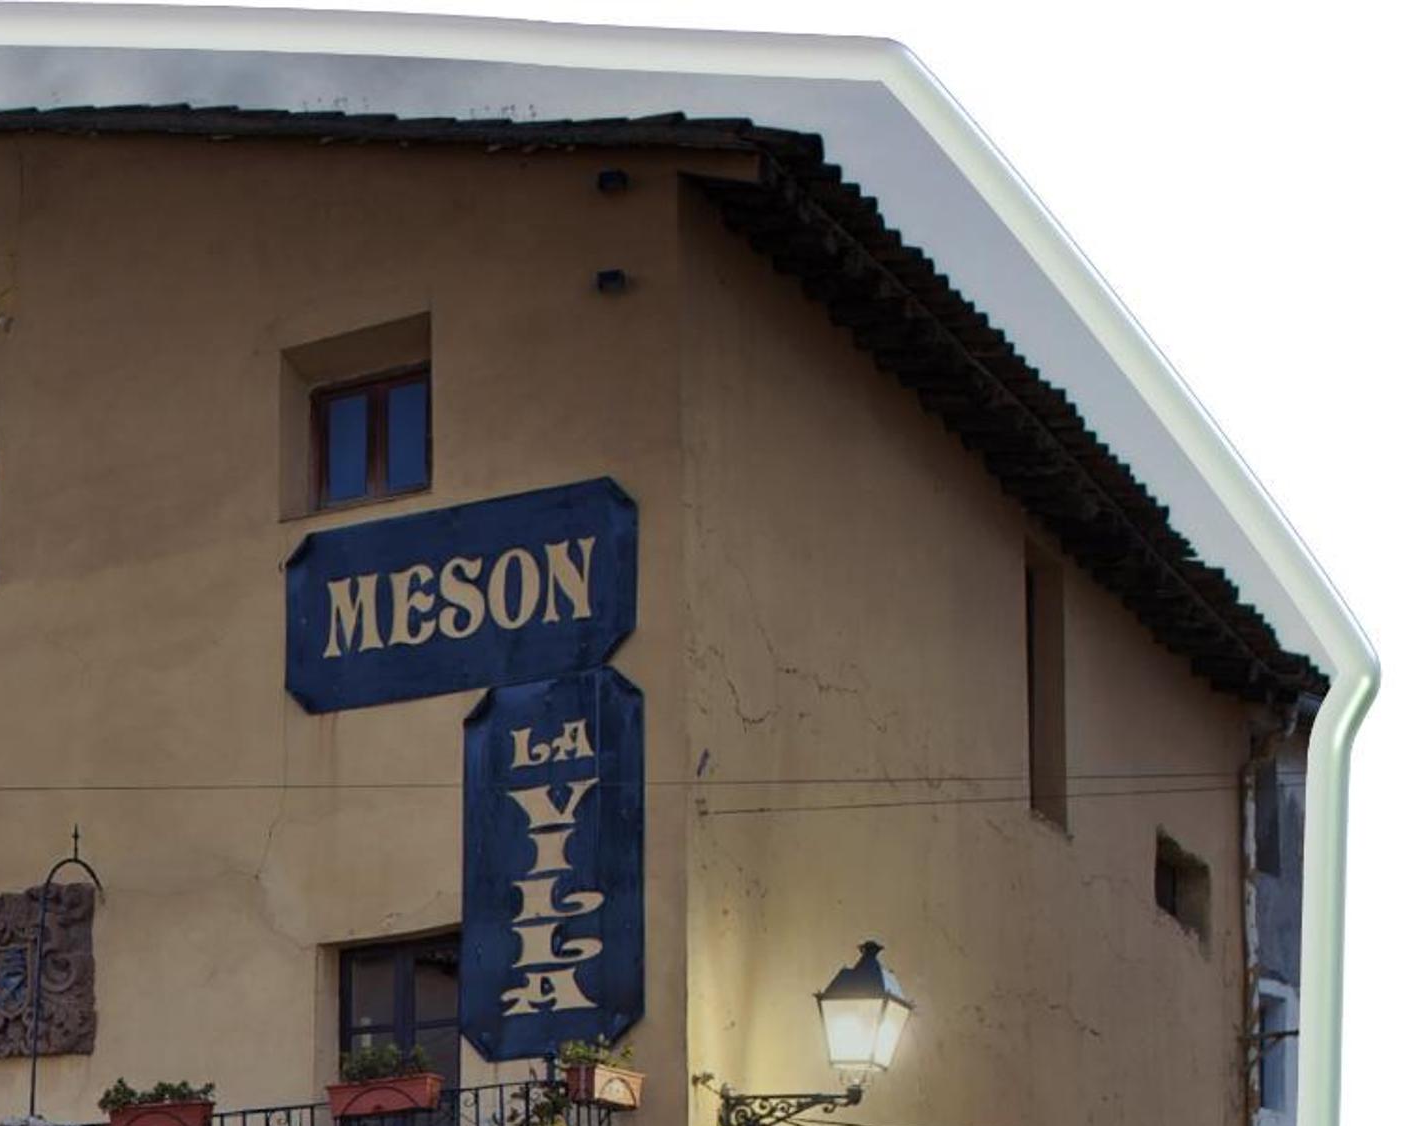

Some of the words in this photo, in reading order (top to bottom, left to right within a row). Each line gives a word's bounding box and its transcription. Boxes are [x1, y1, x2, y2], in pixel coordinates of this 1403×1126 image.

[323, 536, 596, 659] MESON
[510, 718, 595, 770] LA
[501, 777, 605, 1016] VILLA
